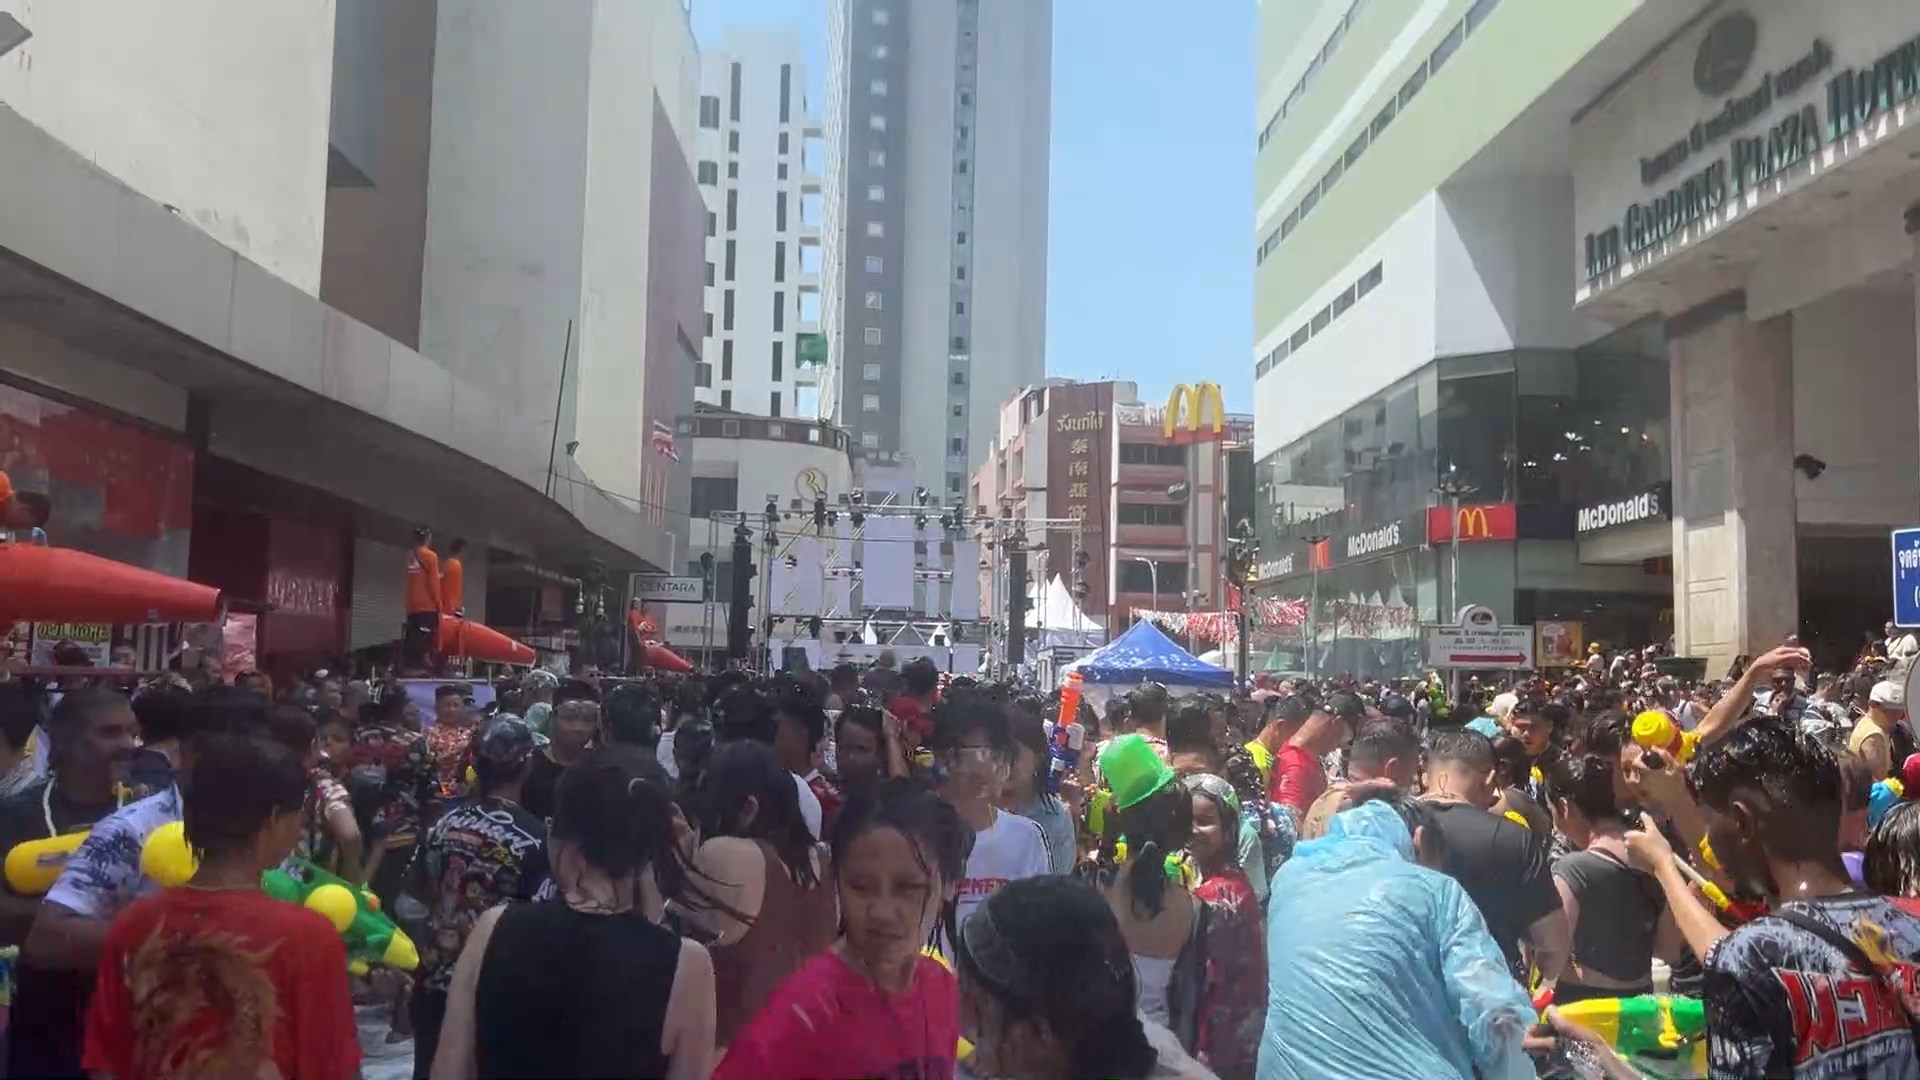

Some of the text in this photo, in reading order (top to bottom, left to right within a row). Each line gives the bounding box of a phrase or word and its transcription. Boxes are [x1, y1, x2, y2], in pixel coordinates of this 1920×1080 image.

[1577, 492, 1660, 532] McDonald's
[1347, 522, 1400, 558] McDonald's
[641, 581, 697, 593] CENTARA
